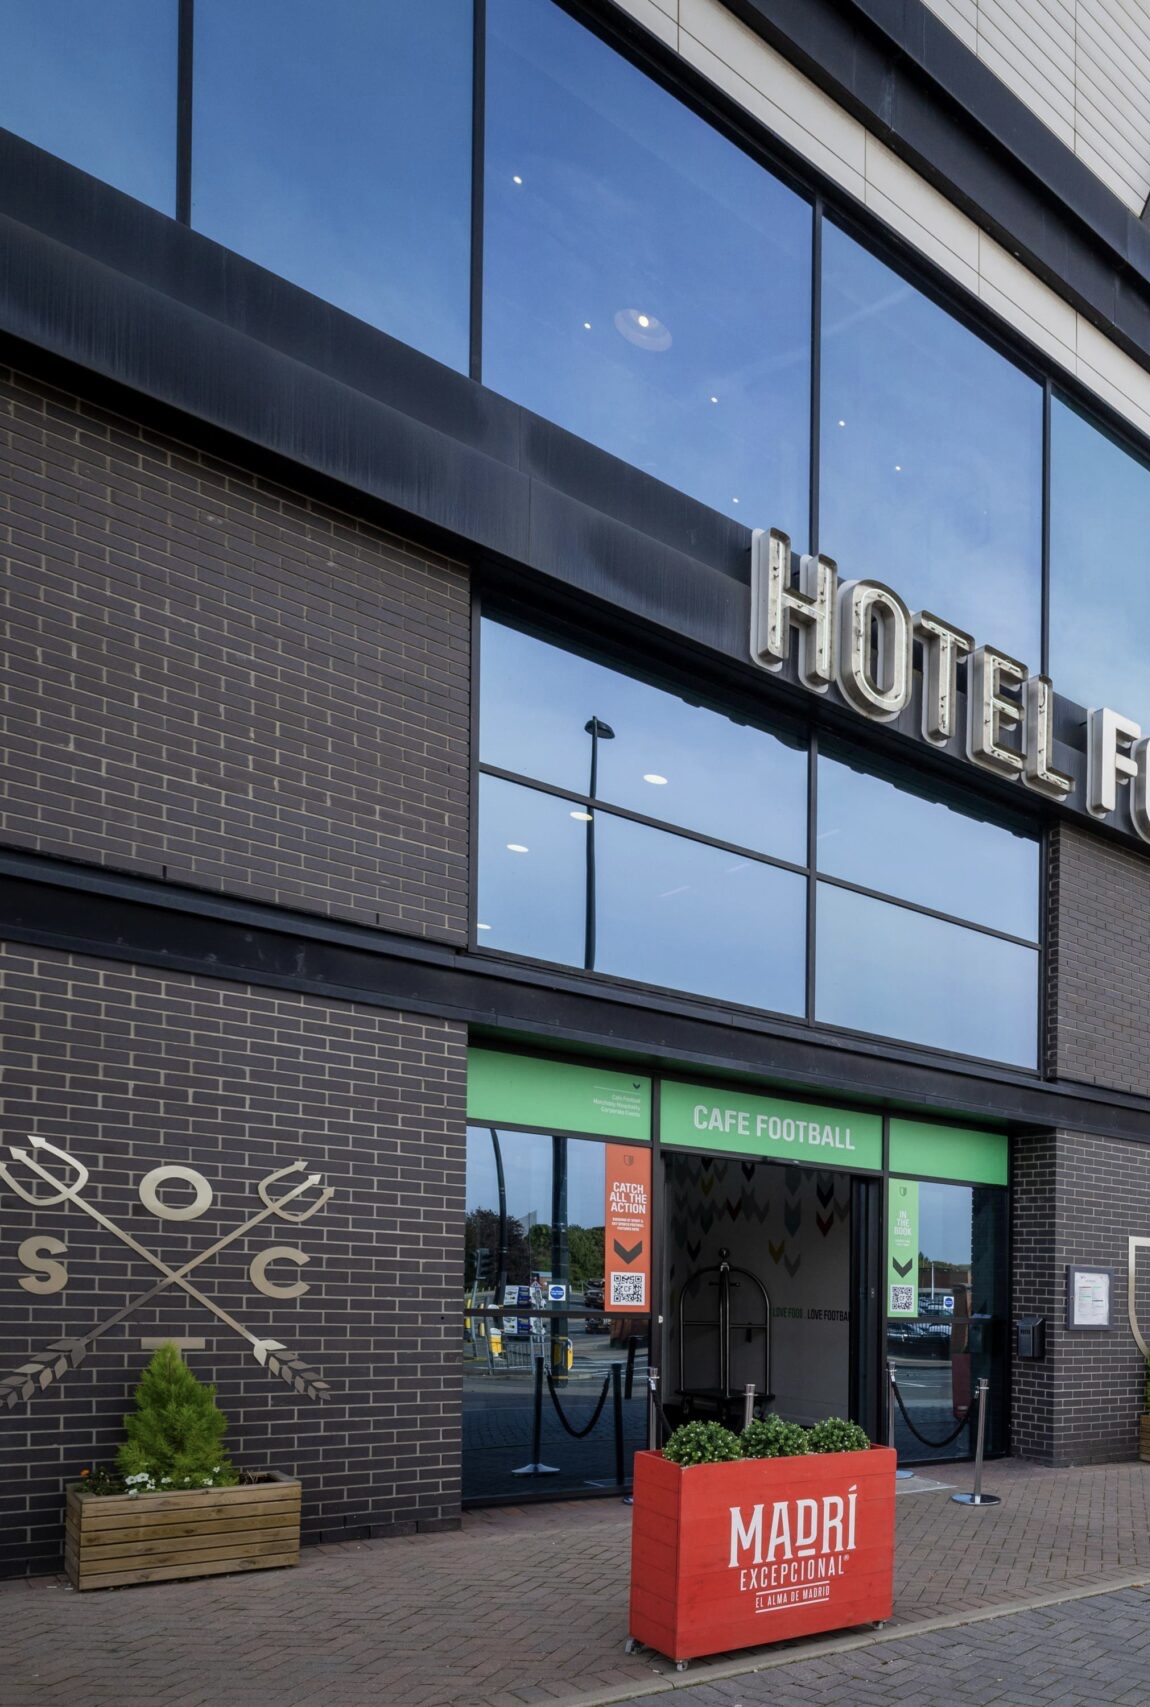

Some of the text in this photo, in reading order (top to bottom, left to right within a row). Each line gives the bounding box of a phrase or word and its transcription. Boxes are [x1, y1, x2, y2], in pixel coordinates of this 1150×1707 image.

[751, 527, 1075, 801] HOTEL
[693, 1105, 856, 1150] CAFE FOOTBALL
[139, 1165, 213, 1221] O
[609, 1191, 648, 1204] ALL THE
[613, 1182, 644, 1194] CATCH
[610, 1201, 646, 1215] ACTION
[17, 1235, 311, 1299] S C
[807, 1308, 823, 1320] LOVE
[728, 1484, 857, 1568] MADRÍ
[755, 1585, 830, 1608] EL ALMA DE MADRID
